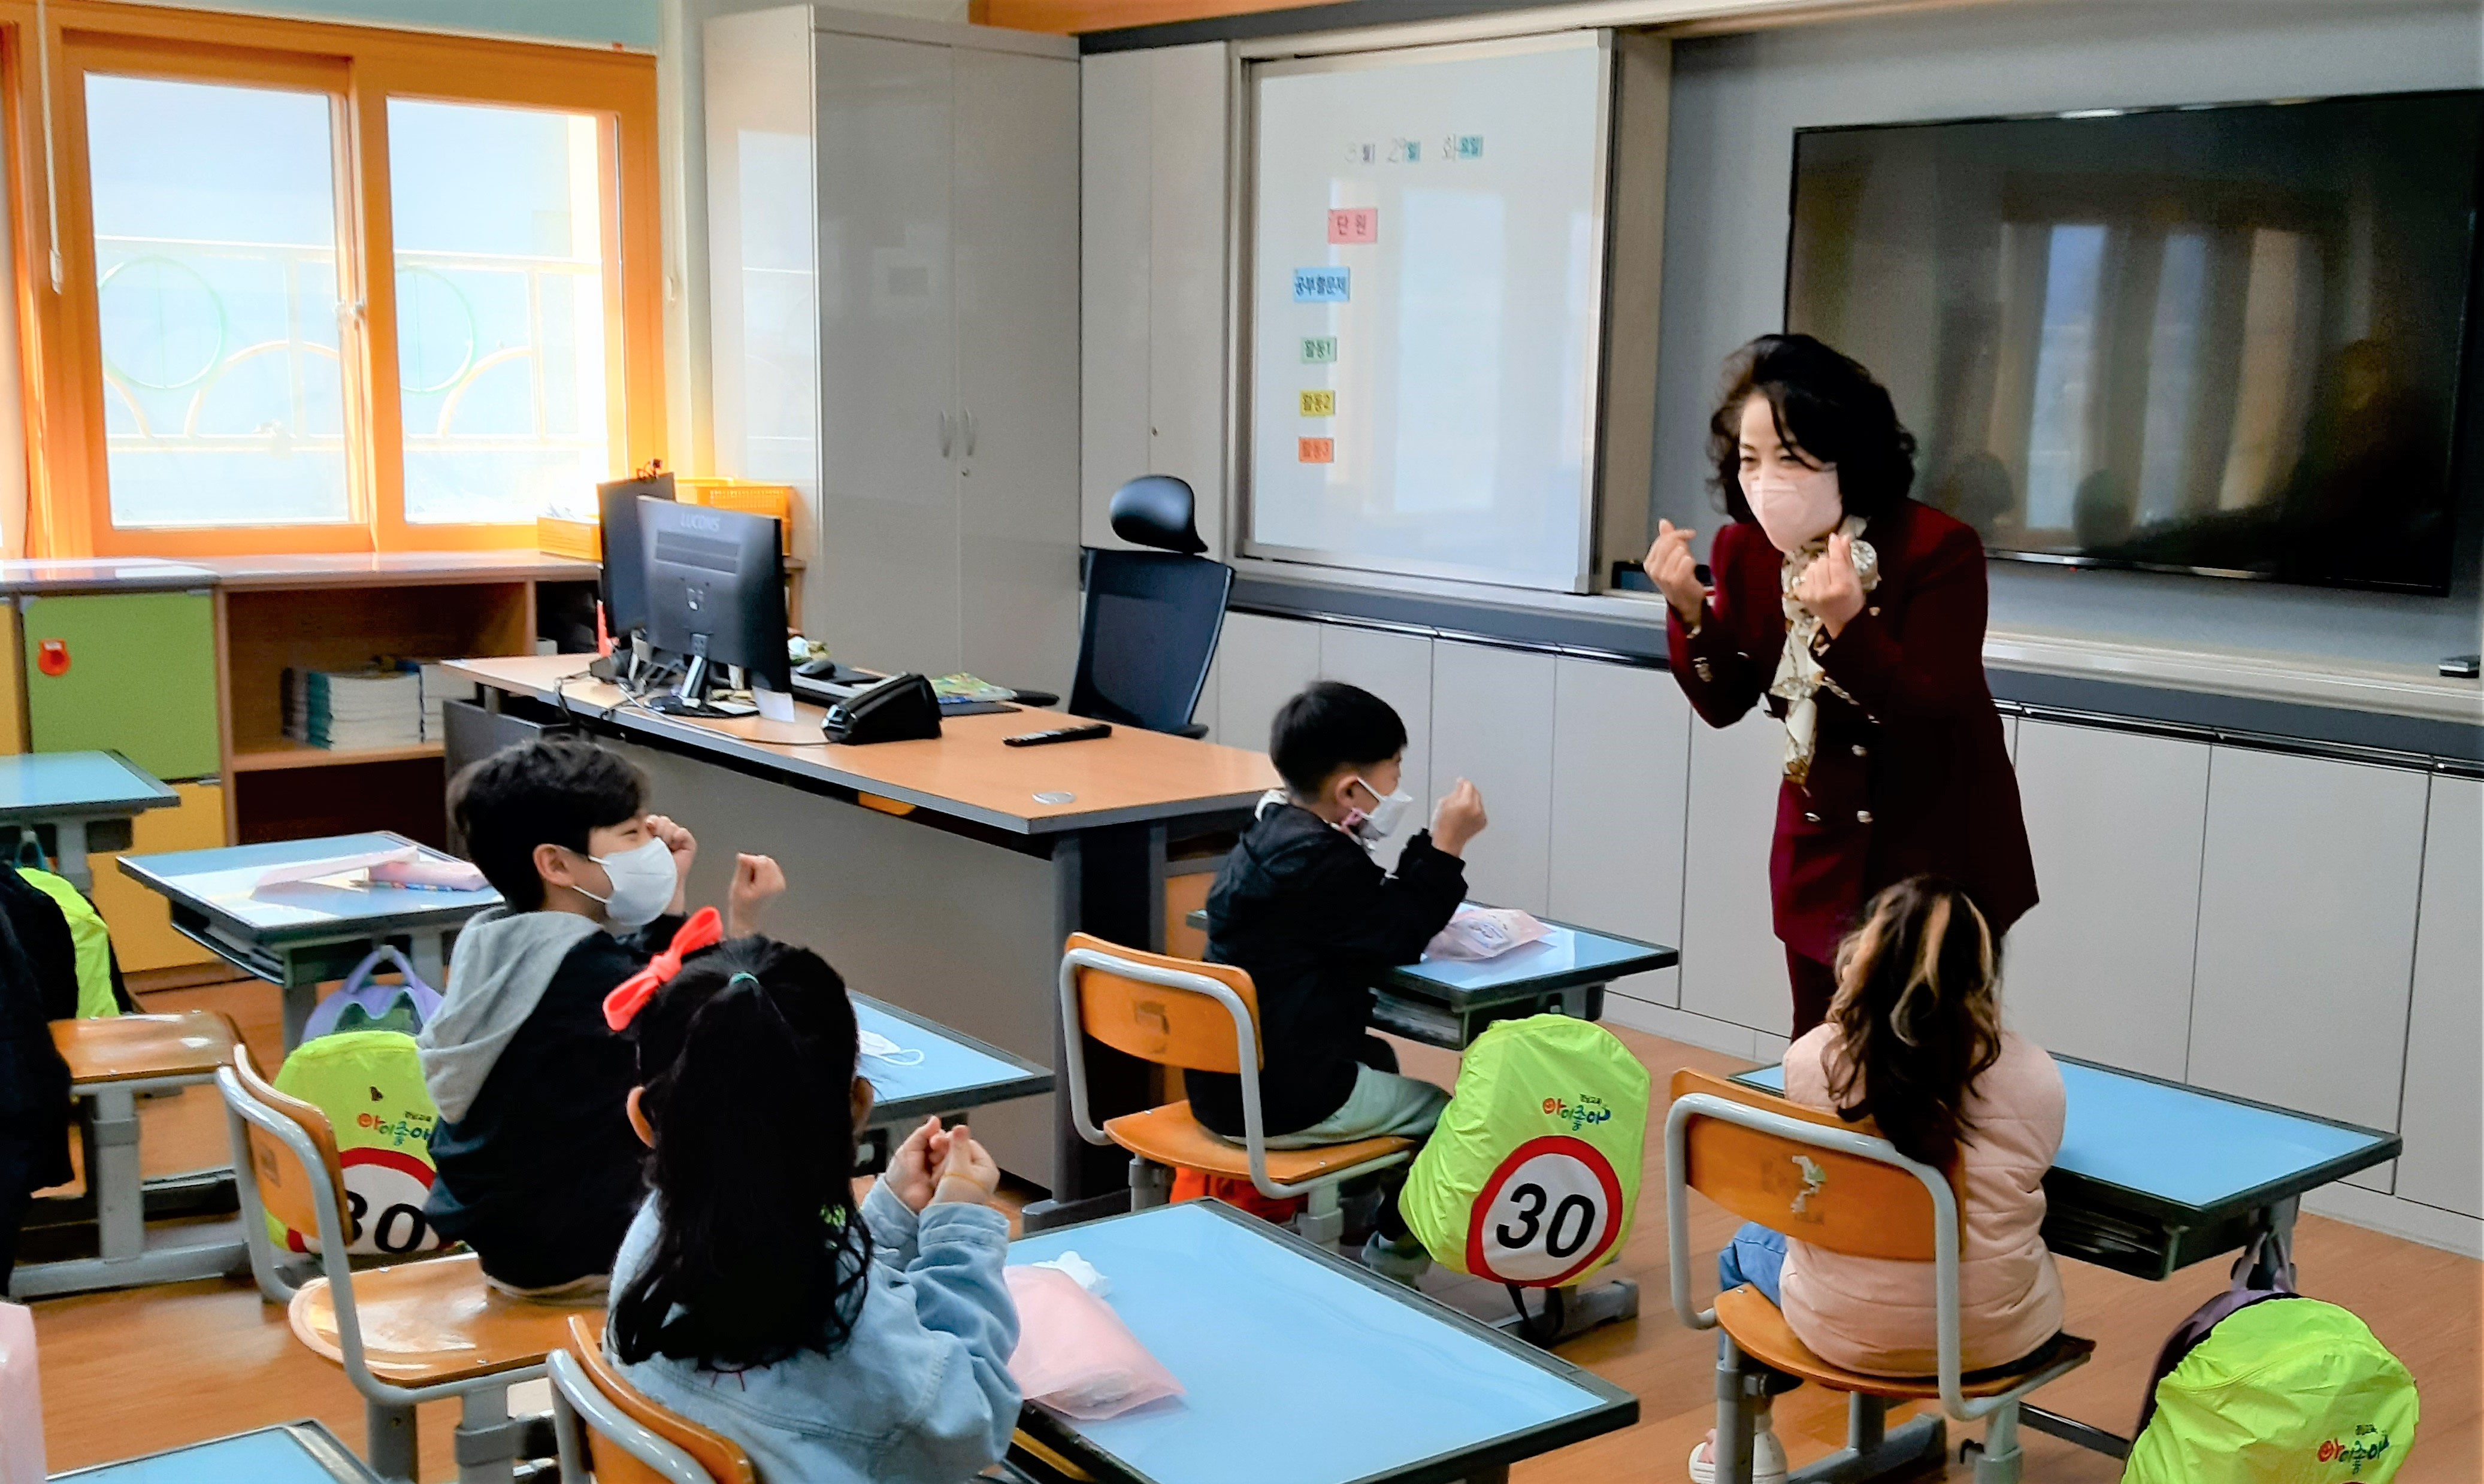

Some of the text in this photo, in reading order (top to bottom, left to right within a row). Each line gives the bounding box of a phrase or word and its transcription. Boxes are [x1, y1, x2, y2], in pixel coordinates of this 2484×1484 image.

[1303, 393, 1330, 412] 활동2
[1542, 1097, 1611, 1131] 아이좋아
[1496, 1183, 1596, 1258] 30
